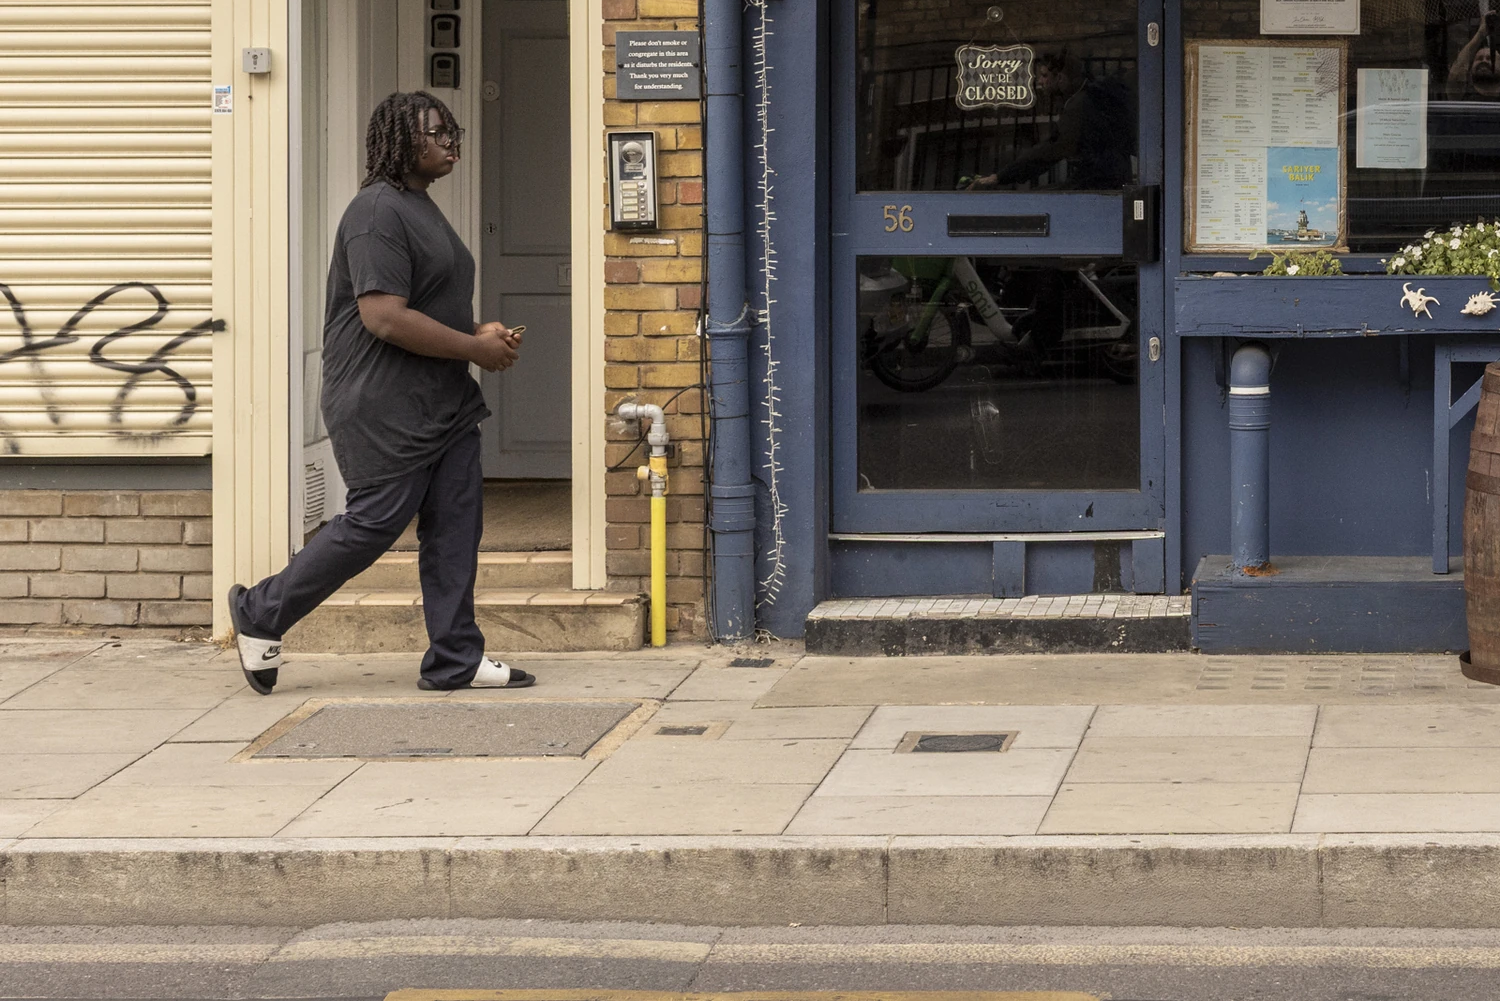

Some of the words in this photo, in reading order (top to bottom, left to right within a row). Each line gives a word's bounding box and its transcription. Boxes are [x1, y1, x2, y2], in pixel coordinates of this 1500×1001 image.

[968, 54, 1023, 74] Sorry
[979, 73, 1012, 83] WE'RE
[965, 85, 1027, 101] CLOSED
[1282, 165, 1321, 173] SARIYER
[1289, 173, 1314, 181] BALIK
[883, 205, 915, 233] 56
